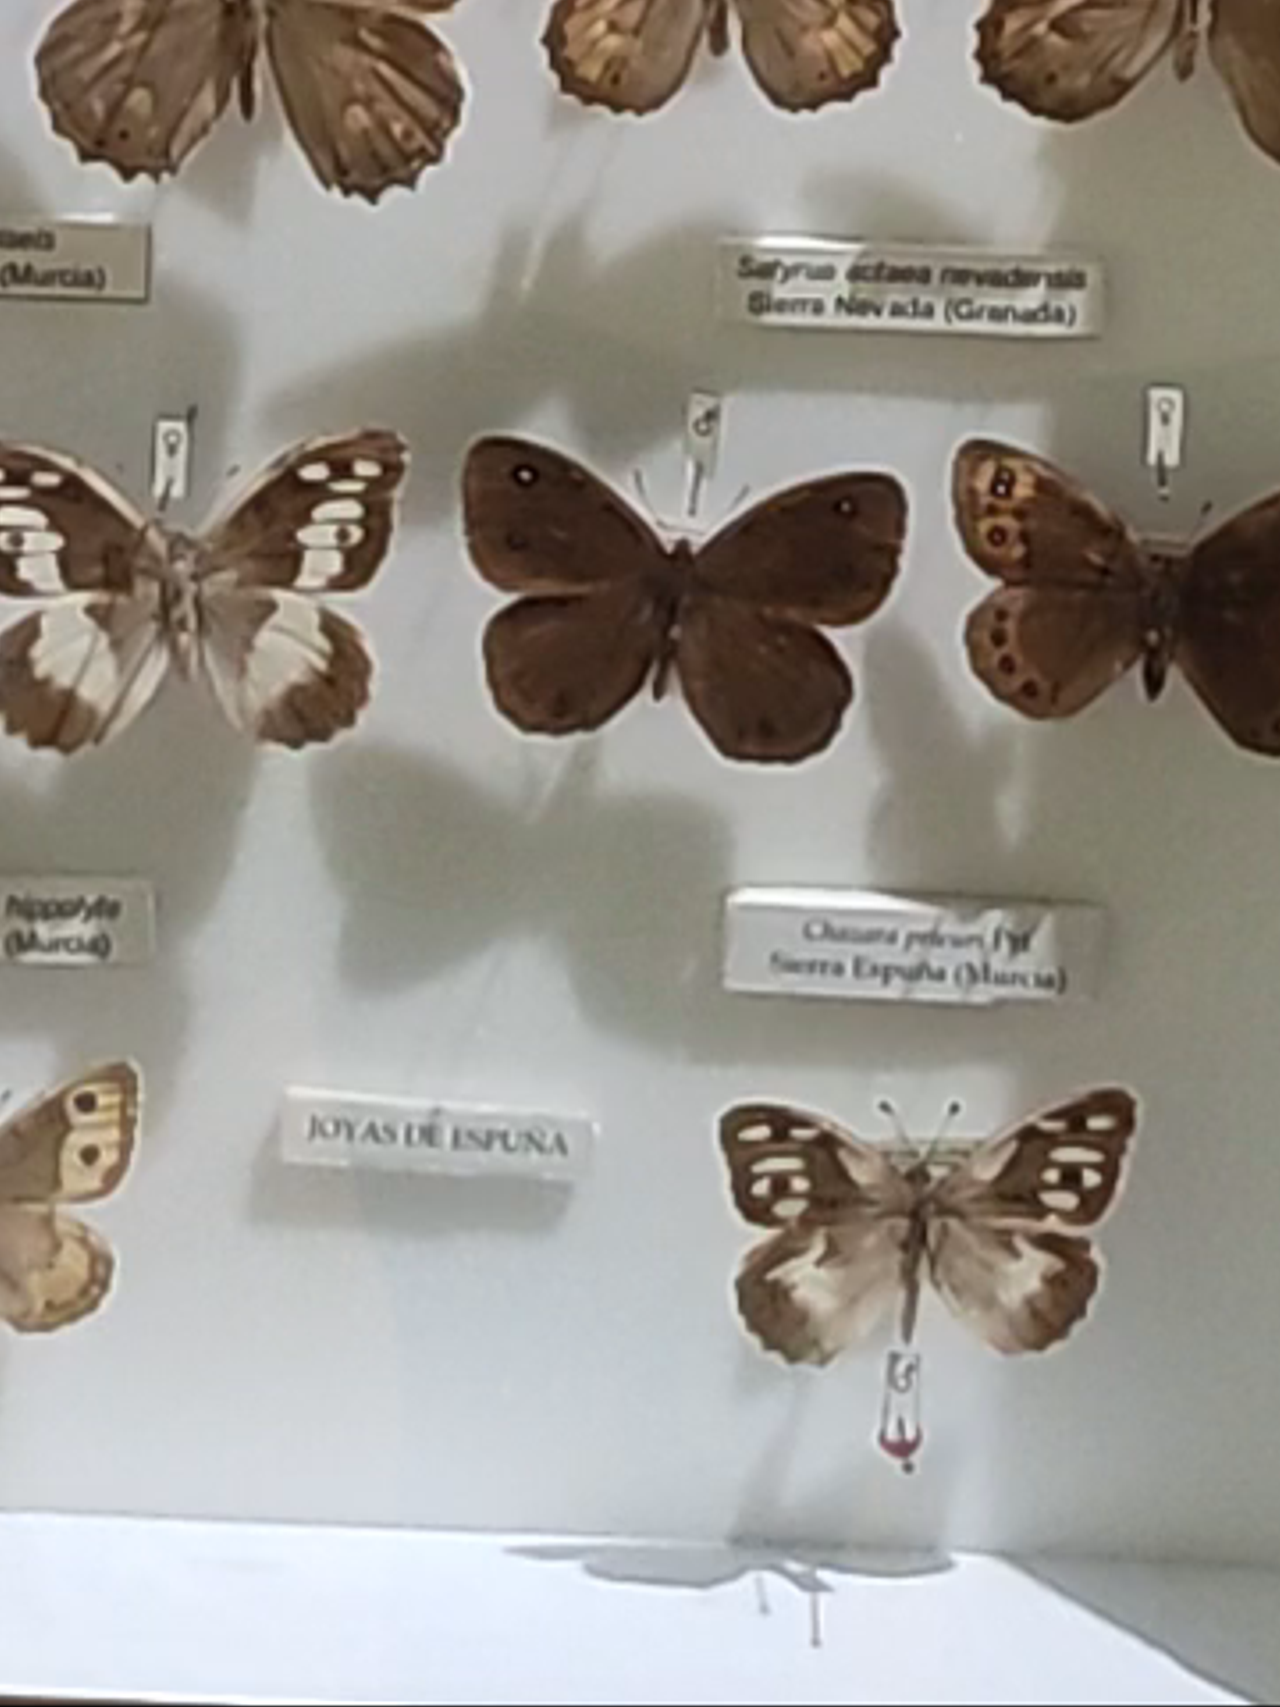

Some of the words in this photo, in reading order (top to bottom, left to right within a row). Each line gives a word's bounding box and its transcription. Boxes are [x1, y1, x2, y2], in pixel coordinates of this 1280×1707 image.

[836, 294, 933, 321] Nevada
[944, 296, 1076, 326] (Granada)
[4, 932, 112, 960] (Murcia)
[308, 1112, 399, 1148] JOYAS
[404, 1117, 443, 1150] DE
[451, 1120, 569, 1158] ESPUÑA
